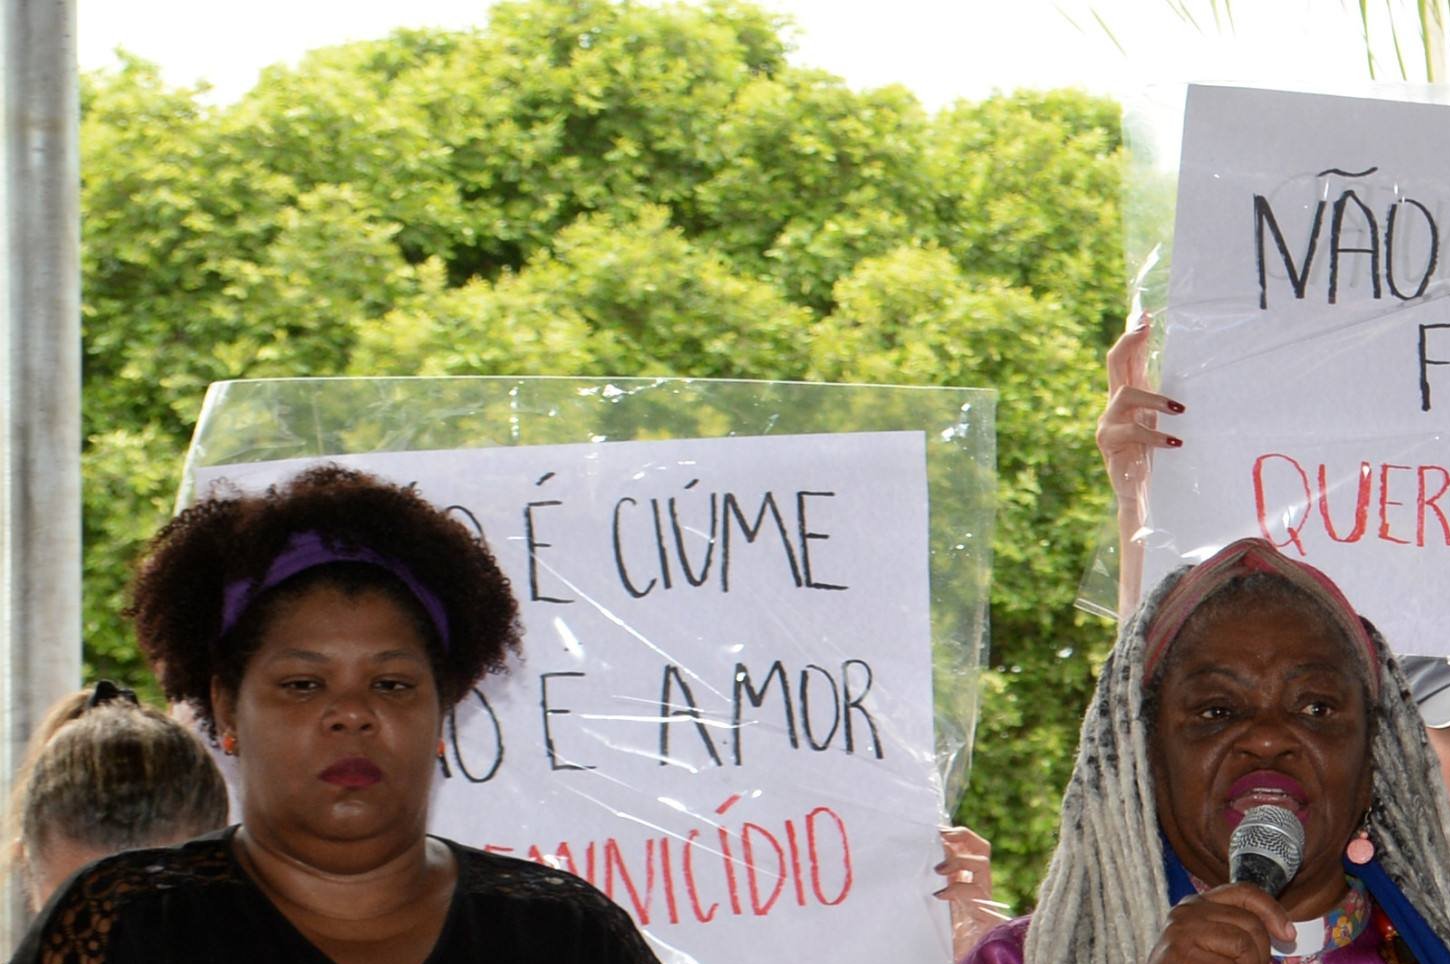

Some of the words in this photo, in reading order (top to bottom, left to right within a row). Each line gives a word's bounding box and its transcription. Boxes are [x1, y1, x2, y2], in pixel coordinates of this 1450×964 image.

[1253, 166, 1440, 311] NÃO
[525, 472, 574, 603] É
[613, 478, 848, 599] CIÚME
[660, 659, 884, 767] AMOR
